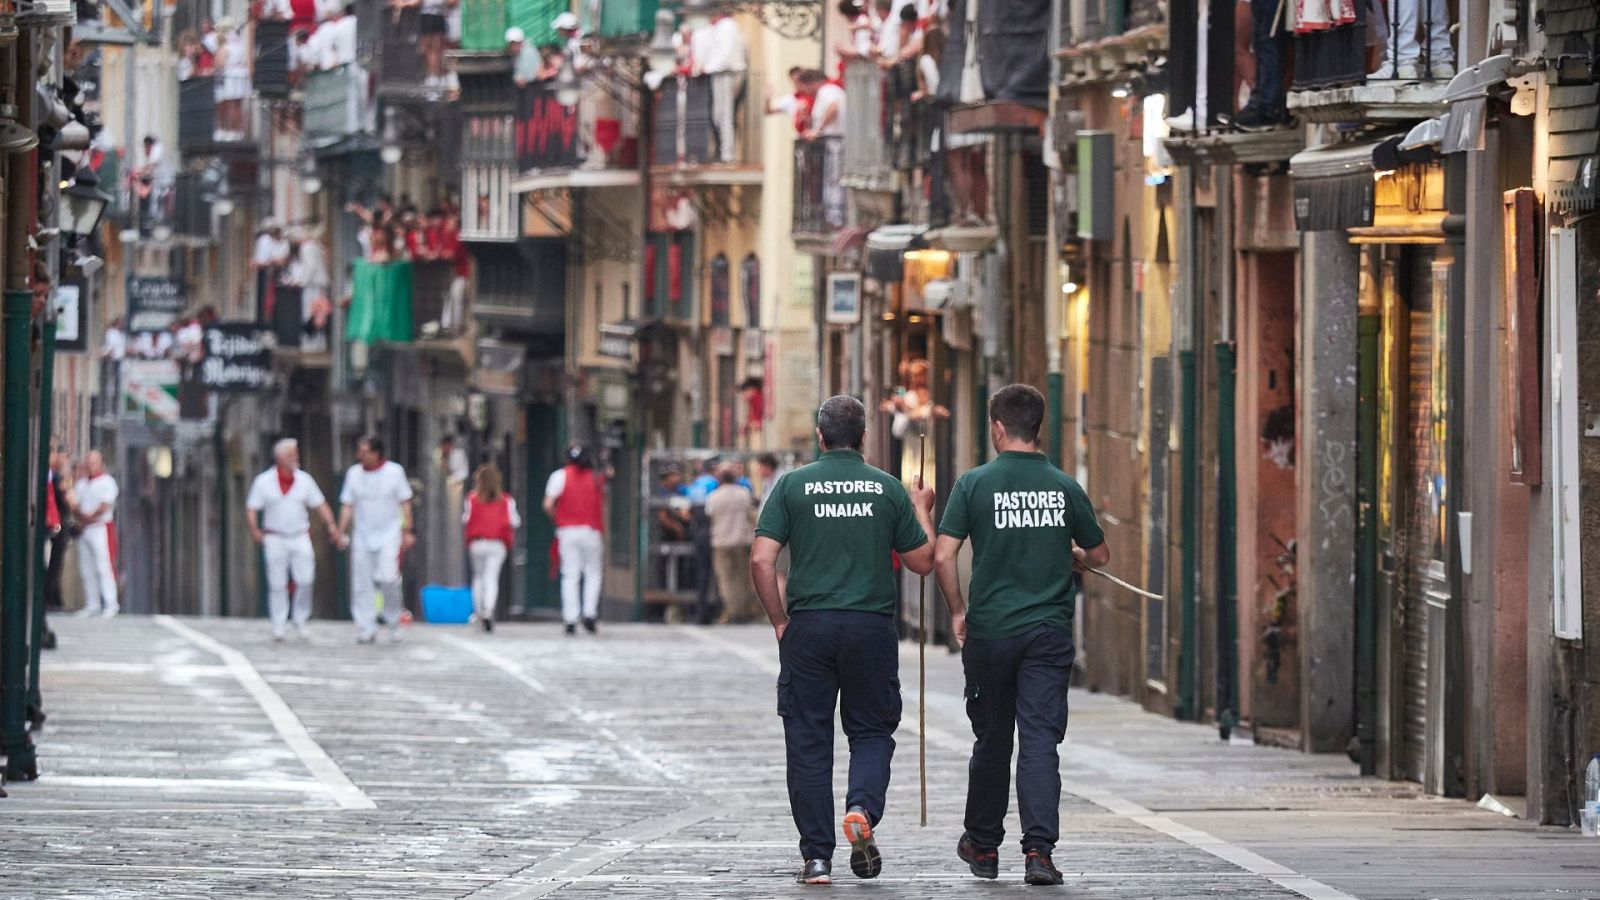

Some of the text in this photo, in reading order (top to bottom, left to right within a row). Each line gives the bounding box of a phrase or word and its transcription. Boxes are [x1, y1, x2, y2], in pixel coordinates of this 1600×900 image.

[804, 480, 884, 497] PASTORES
[993, 491, 1065, 510] PASTORES
[814, 502, 874, 518] UNAIAK
[994, 508, 1066, 529] UNAIAK
